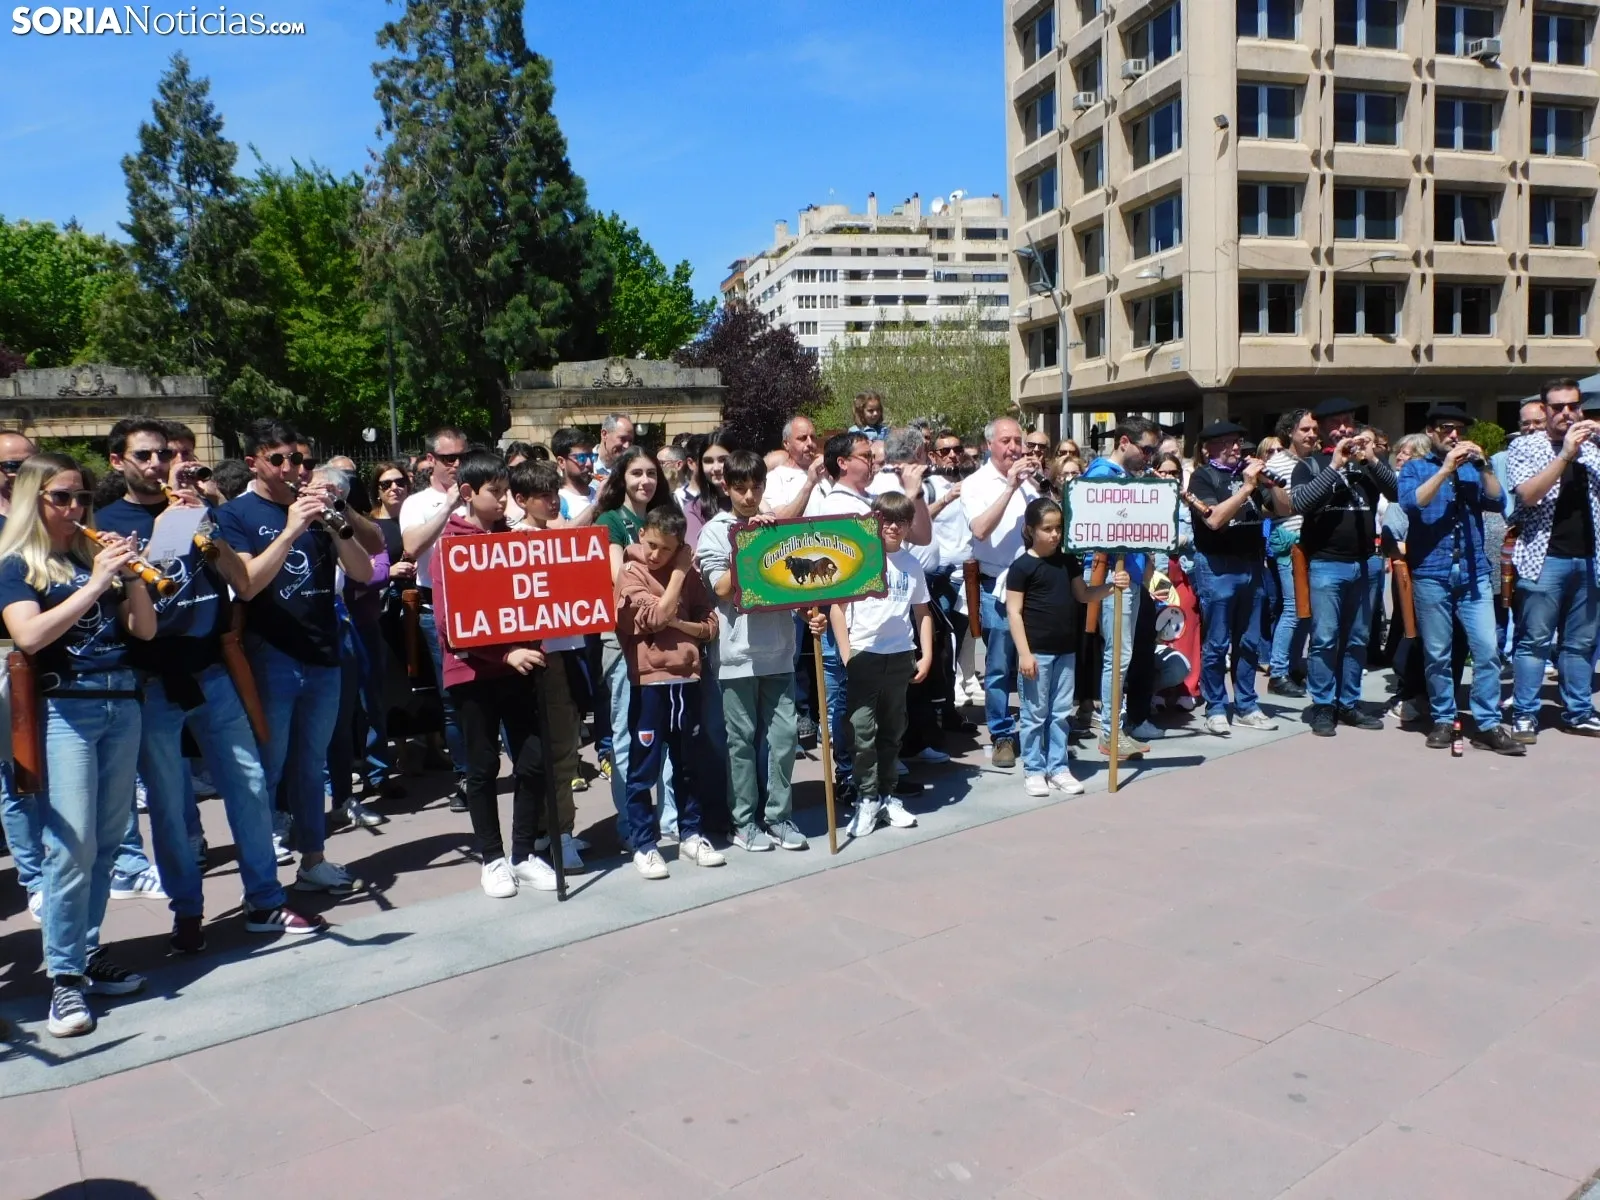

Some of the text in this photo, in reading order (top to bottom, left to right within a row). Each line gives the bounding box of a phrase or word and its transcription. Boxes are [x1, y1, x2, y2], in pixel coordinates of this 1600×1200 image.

[1086, 488, 1159, 504] CUADRILLA
[1116, 507, 1128, 519] de
[1075, 523, 1103, 542] STA.
[448, 535, 605, 573] CUADRILLA
[763, 531, 856, 569] Cuadrilla de San Juan
[512, 572, 550, 600] DE
[455, 598, 610, 639] LA BLANCA
